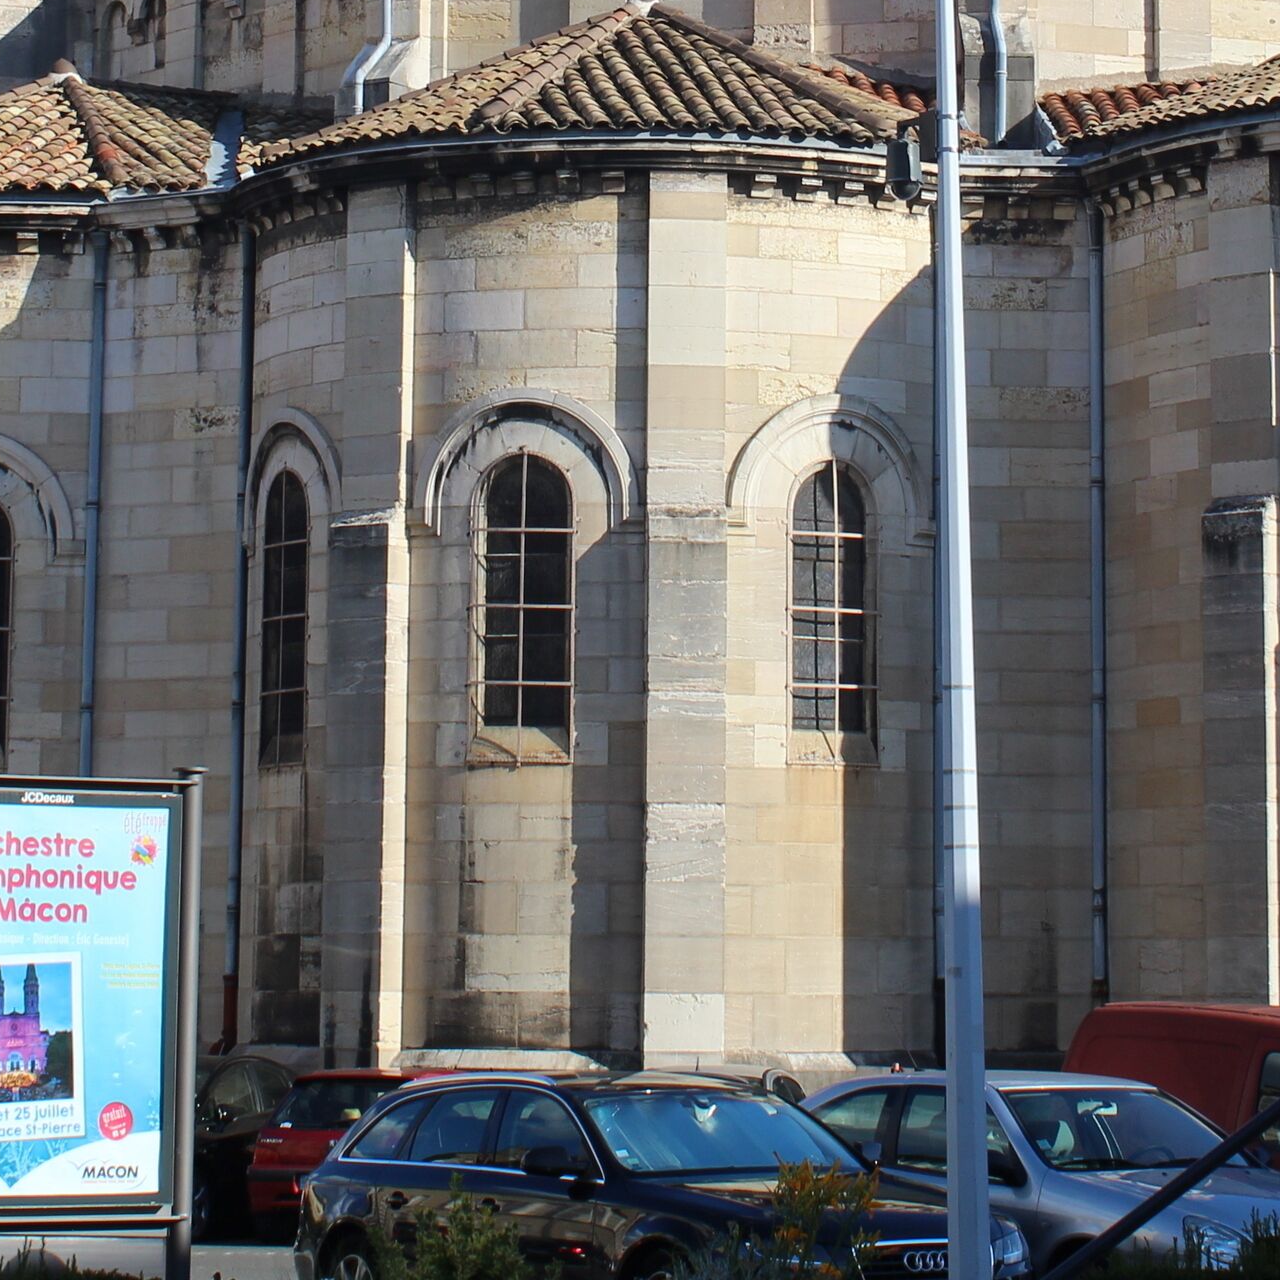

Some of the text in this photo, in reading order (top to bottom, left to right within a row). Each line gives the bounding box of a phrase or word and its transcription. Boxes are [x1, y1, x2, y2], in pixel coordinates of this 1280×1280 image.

[21, 791, 75, 804] JCDecaux
[14, 1106, 31, 1121] 25
[34, 1103, 75, 1122] juillet
[25, 1122, 81, 1136] St-Pierre
